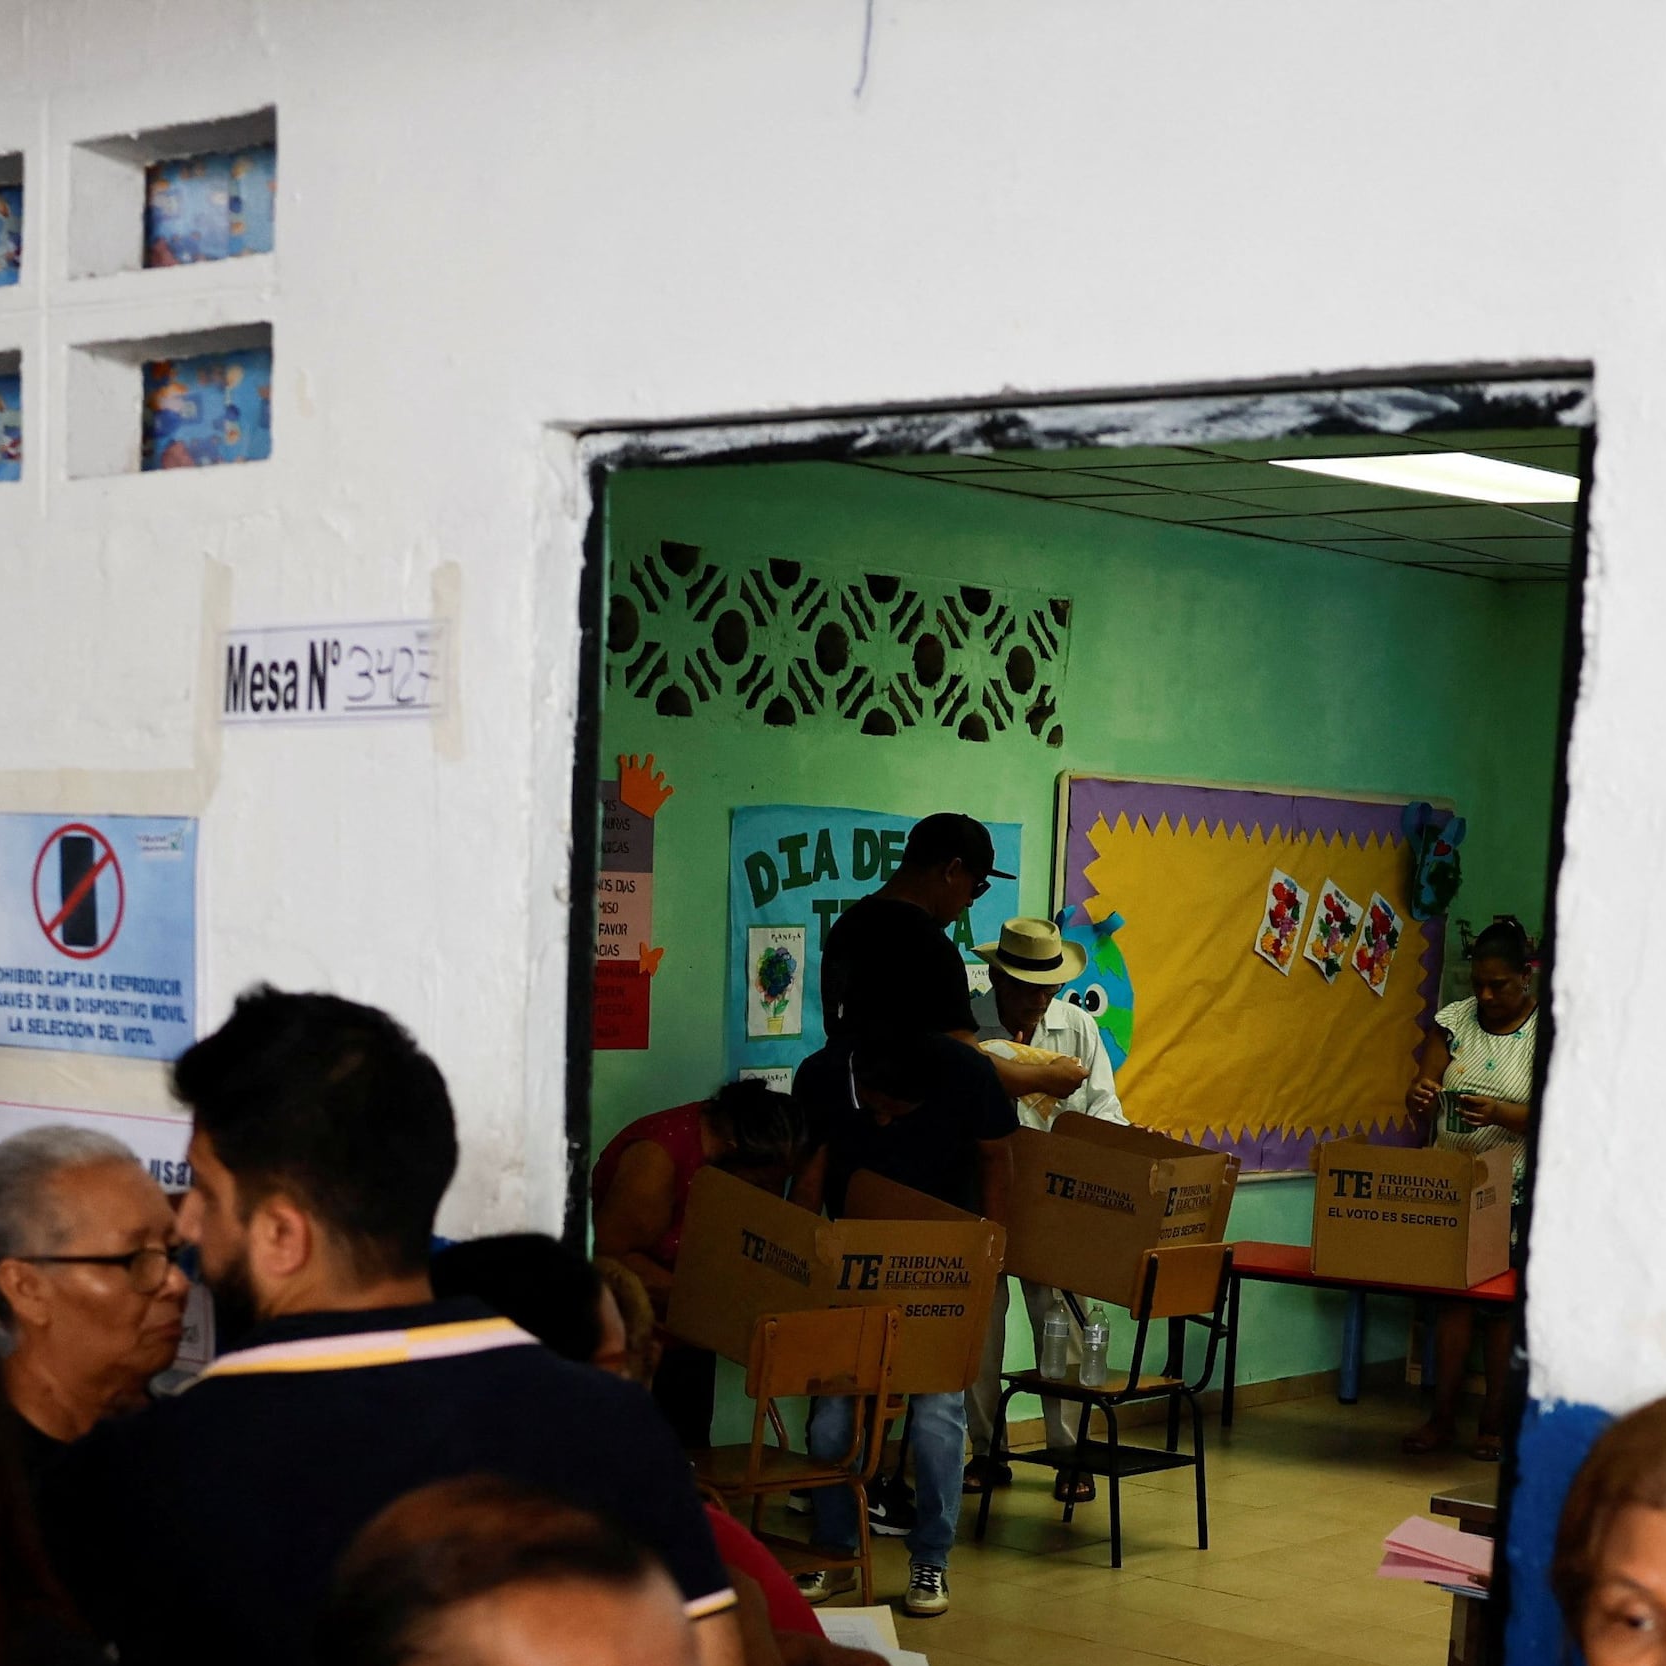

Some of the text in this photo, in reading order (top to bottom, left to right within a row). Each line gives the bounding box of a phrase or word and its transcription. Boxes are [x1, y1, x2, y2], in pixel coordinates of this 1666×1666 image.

[224, 643, 300, 713] Mesa
[744, 828, 840, 909] DIA
[598, 923, 628, 936] FAVOR
[47, 970, 94, 988] CAPTAR
[100, 974, 107, 990] O
[111, 974, 182, 997] REPRODUCIR
[35, 995, 51, 1011] DE
[75, 998, 147, 1019] DISPOSITIVO
[8, 1016, 24, 1033] LA
[99, 1023, 119, 1041] DEL
[1045, 1172, 1133, 1202] TE TRIBUNAL
[1329, 1168, 1453, 1200] TE TRIBUNAL
[1377, 1185, 1462, 1202] ELECTORAL
[1076, 1190, 1136, 1215] ELECTORAL
[1163, 1184, 1212, 1217] E TRIBUNAL
[1180, 1222, 1207, 1238] SECRETO
[1328, 1207, 1459, 1229] EL VOTO ES SECRETO
[837, 1254, 965, 1290] TE TRIBUNAL
[884, 1270, 972, 1285] ELECTORAL
[904, 1303, 965, 1317] SECRETO
